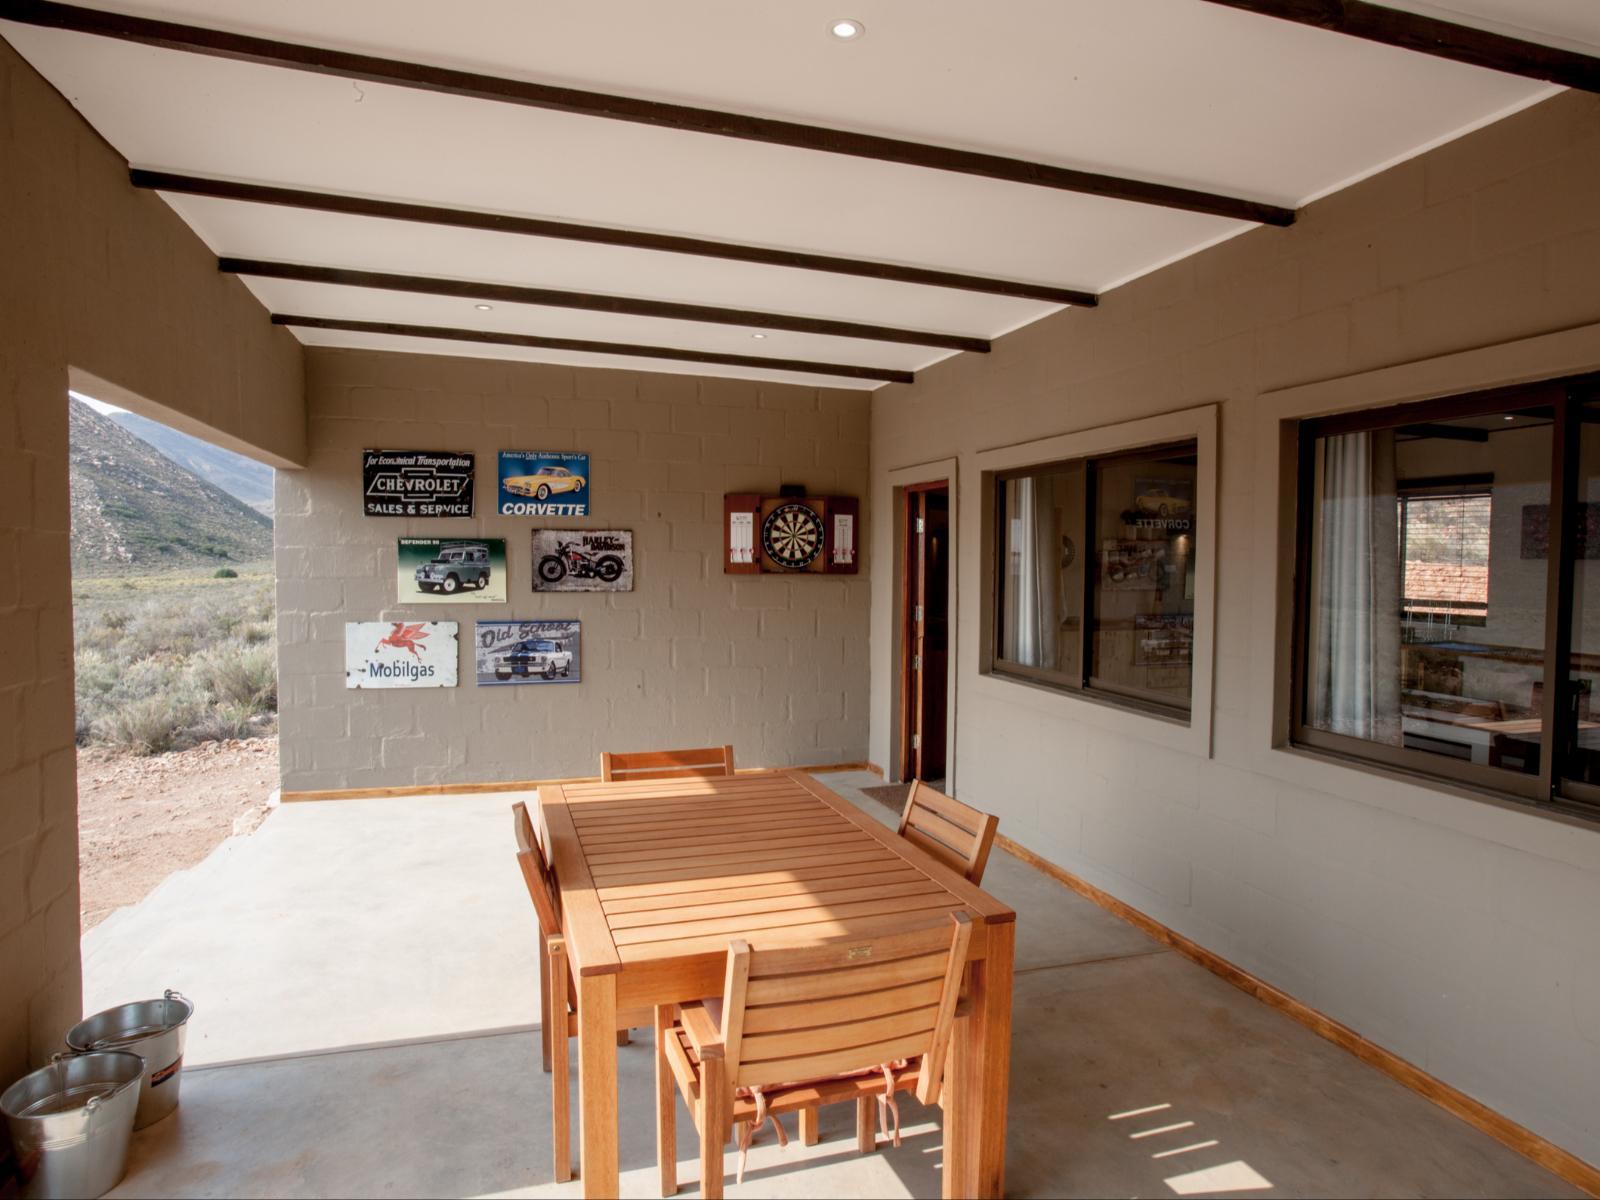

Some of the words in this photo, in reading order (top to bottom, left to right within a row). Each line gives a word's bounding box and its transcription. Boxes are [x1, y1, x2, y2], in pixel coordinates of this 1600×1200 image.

[365, 456, 378, 468] for
[417, 455, 471, 469] Transportation
[376, 479, 460, 491] CHEVROLET
[367, 503, 403, 514] SALES
[406, 504, 416, 514] &
[419, 504, 469, 514] SERVICE
[502, 502, 586, 516] CORVETTE
[480, 625, 514, 648] Old
[369, 660, 435, 681] Mobilgas
